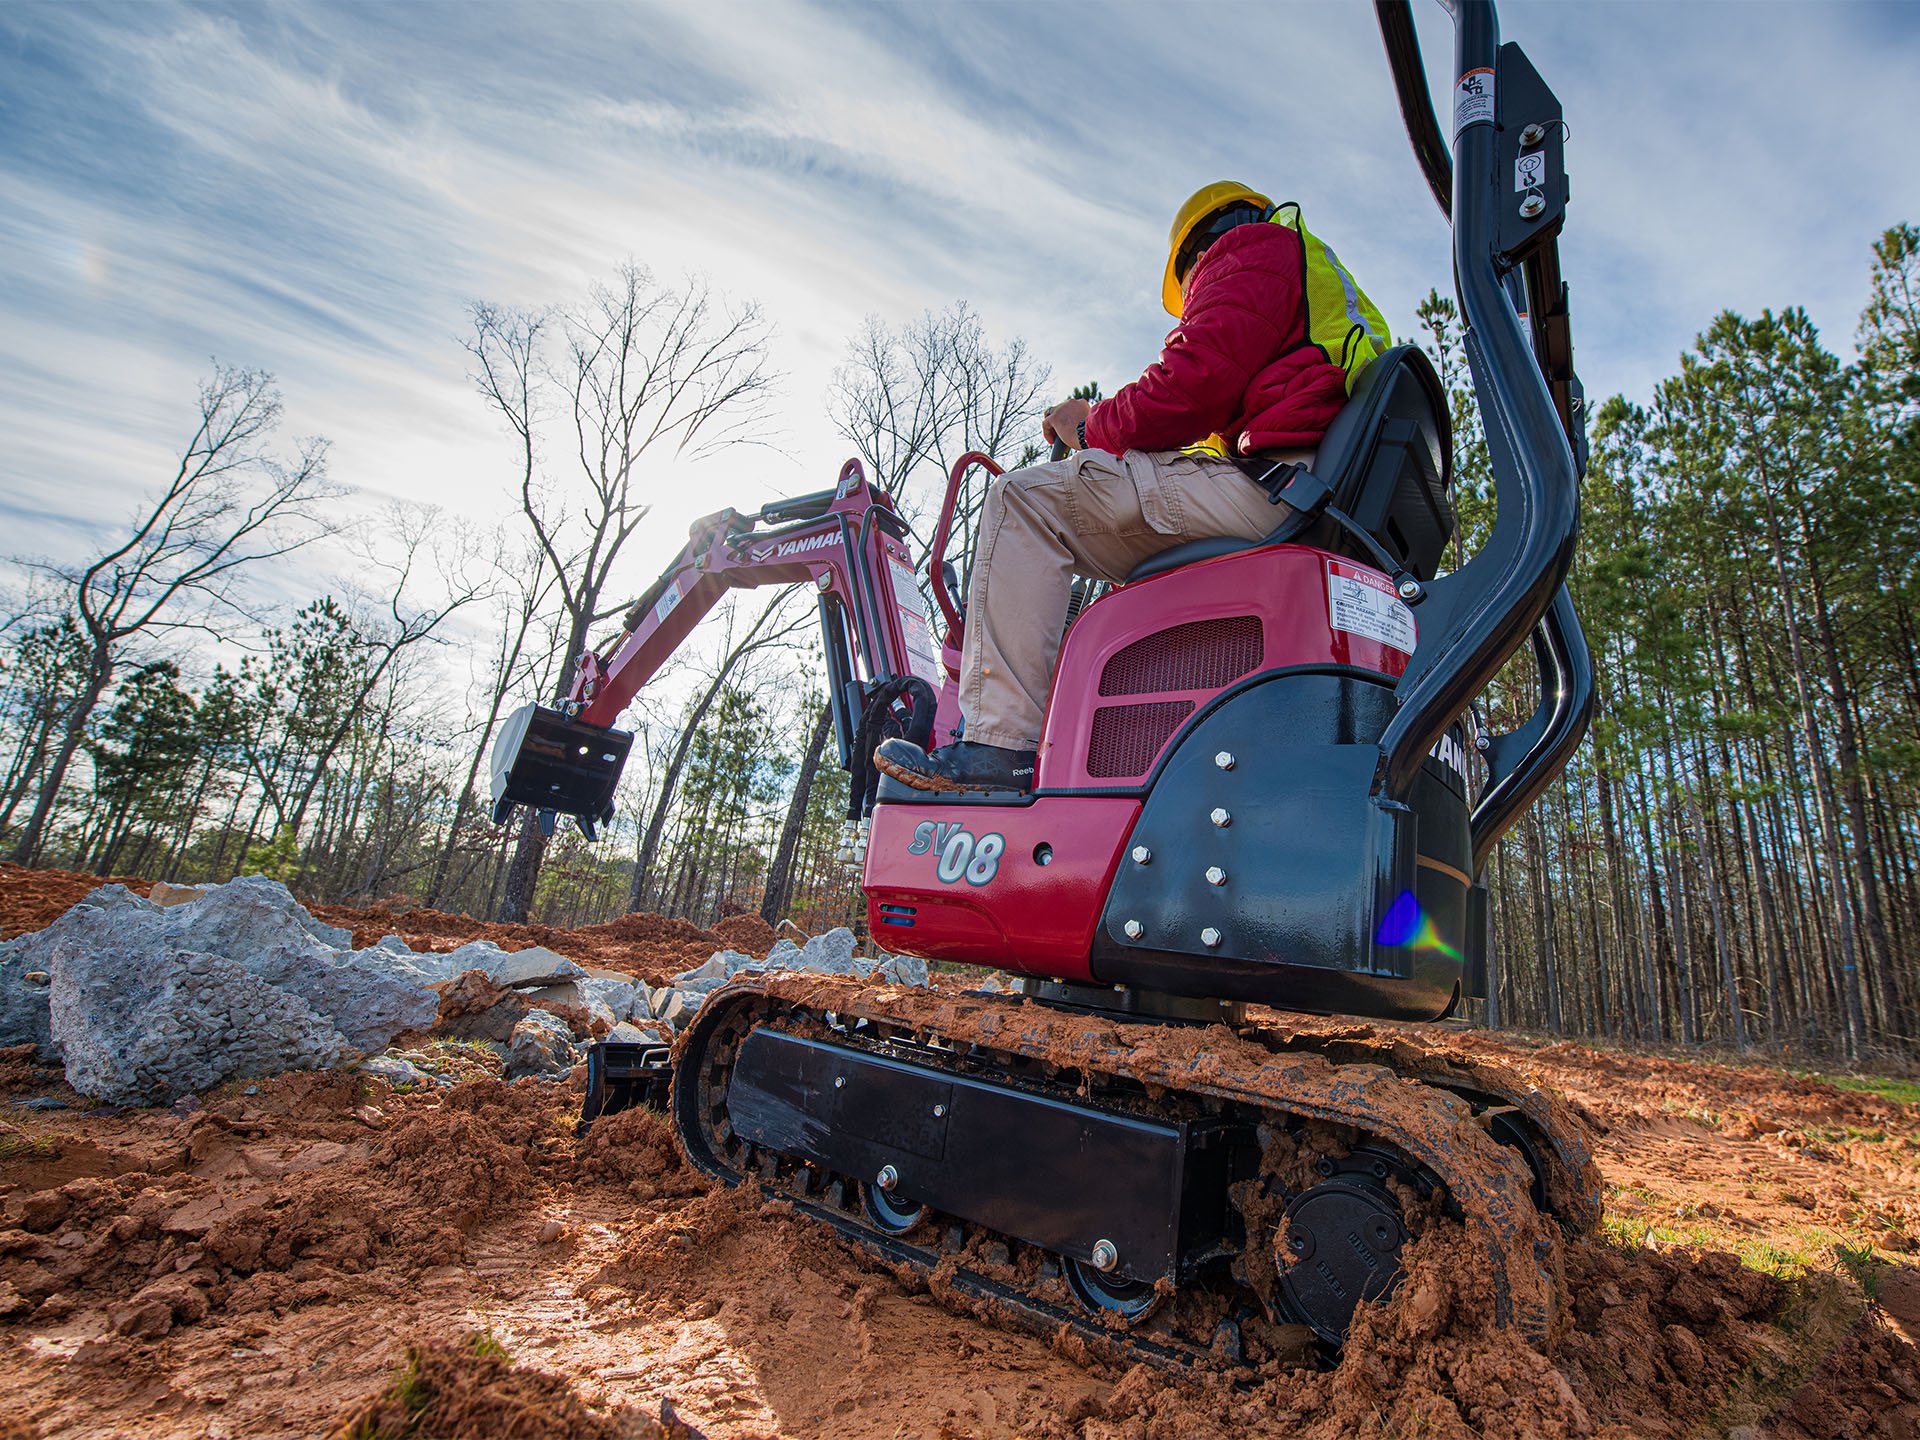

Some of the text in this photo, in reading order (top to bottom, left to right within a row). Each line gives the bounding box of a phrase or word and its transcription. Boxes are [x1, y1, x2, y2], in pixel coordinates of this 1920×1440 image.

[777, 530, 844, 557] YANMAR
[1363, 575, 1397, 596] DANGER
[1336, 600, 1354, 609] CRUSH
[1347, 1232, 1378, 1270] DRAIN
[1316, 1260, 1347, 1299] LEVEL
